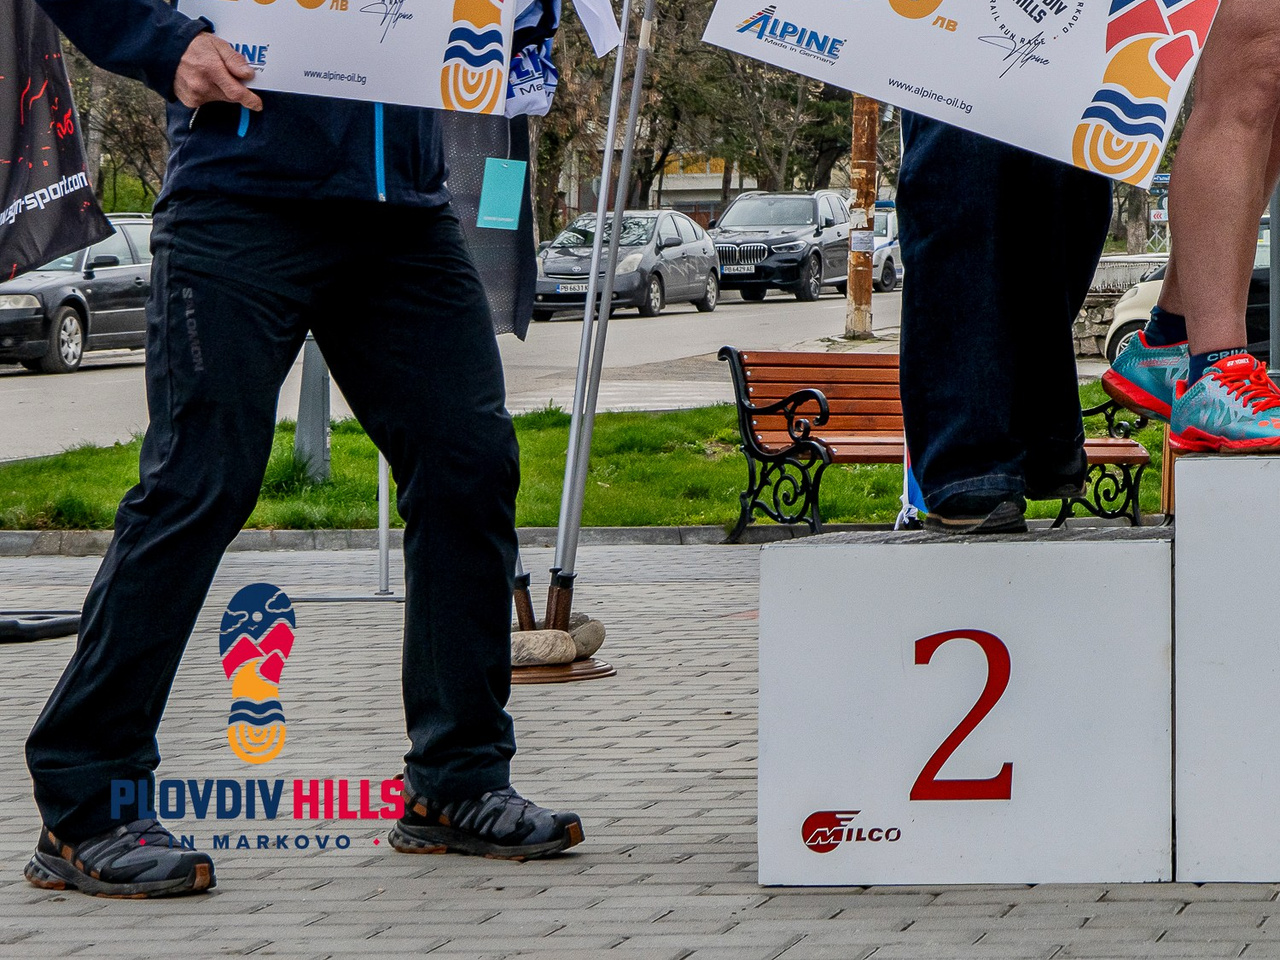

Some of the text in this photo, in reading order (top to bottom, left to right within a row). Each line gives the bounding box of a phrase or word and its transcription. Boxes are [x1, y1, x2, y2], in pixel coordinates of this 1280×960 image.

[736, 6, 845, 60] ALPINE
[932, 15, 958, 32] лв
[764, 37, 787, 49] Made
[799, 49, 836, 66] Germany
[304, 70, 367, 85] www.alpine-oil.bg
[888, 77, 973, 114] www.alpine-oil.bg
[909, 629, 1013, 802] 2
[806, 827, 901, 845] MILCO
